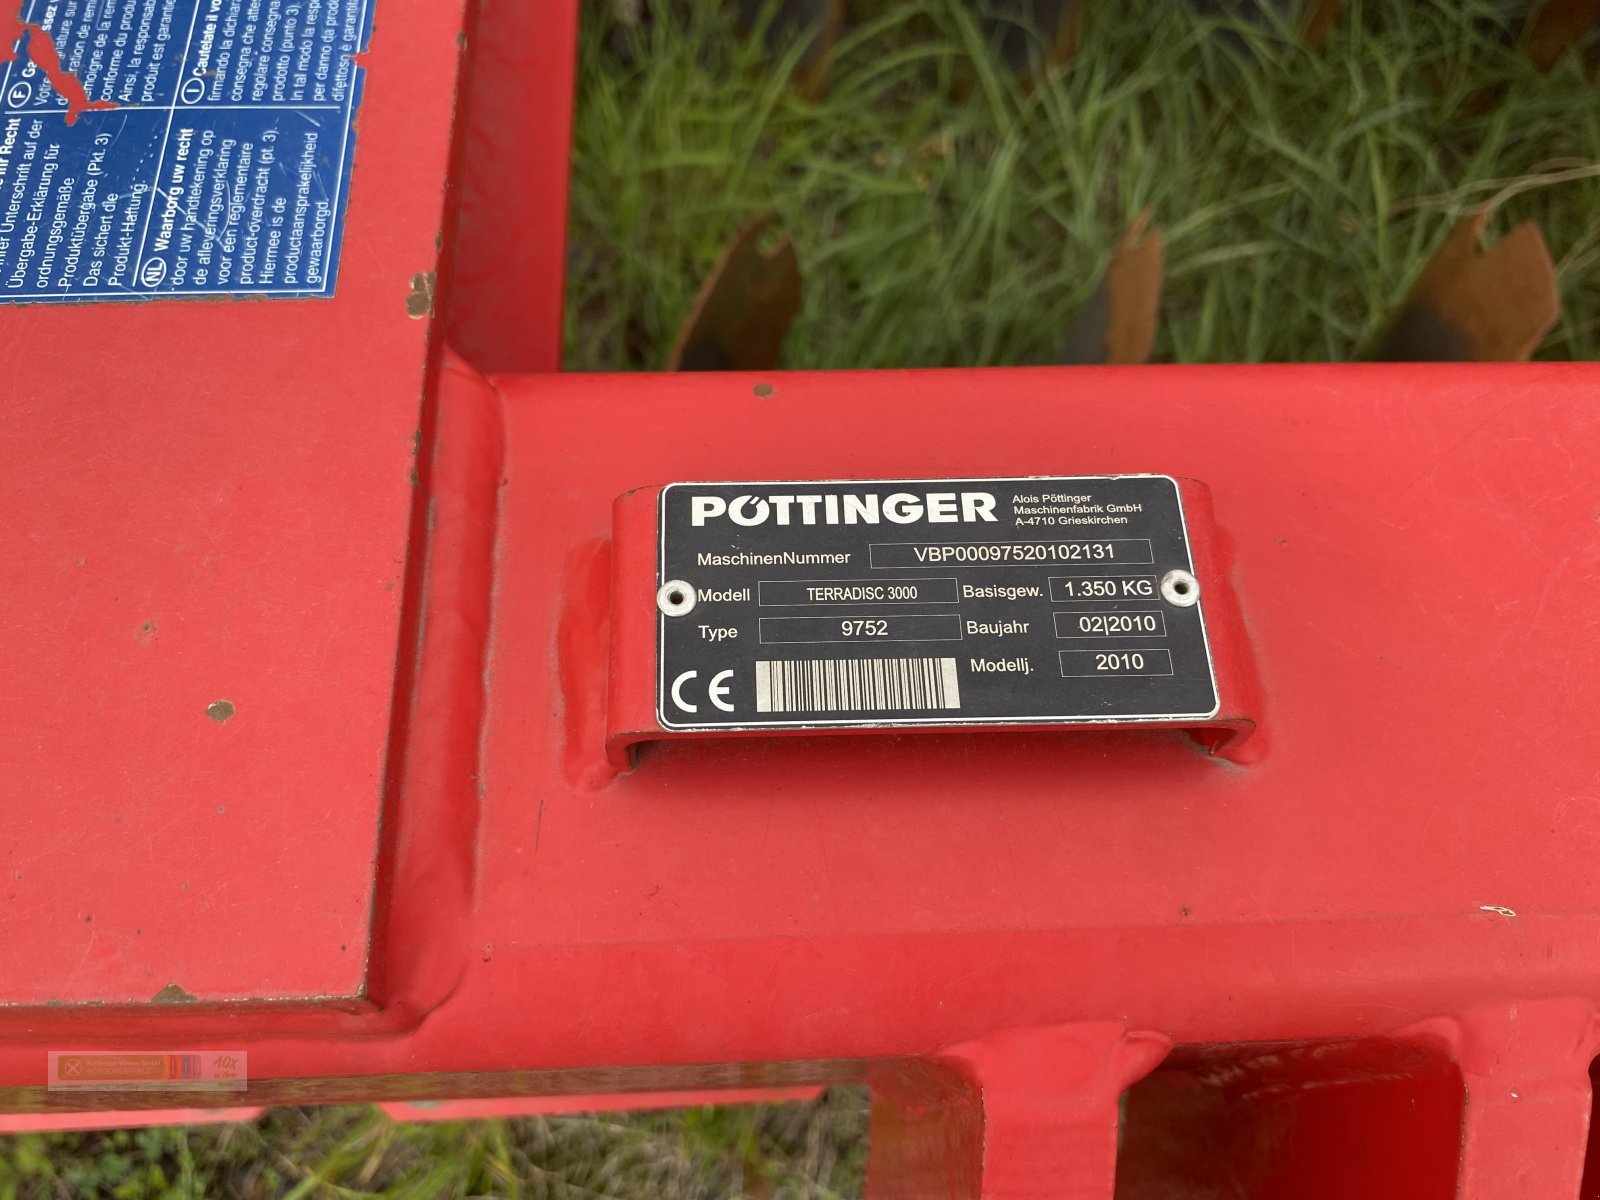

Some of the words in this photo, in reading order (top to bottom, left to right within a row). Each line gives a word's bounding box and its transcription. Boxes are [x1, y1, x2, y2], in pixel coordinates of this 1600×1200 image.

[65, 0, 78, 17] sur
[77, 24, 90, 38] de
[98, 21, 111, 30] la
[279, 18, 297, 52] (punto
[301, 28, 315, 37] la
[94, 34, 108, 47] de
[321, 29, 335, 42] da
[193, 23, 216, 76] Cautelate
[252, 55, 270, 101] regolare
[261, 1, 281, 52] consegna
[298, 40, 313, 71] modo
[101, 50, 123, 101] conforme
[114, 33, 127, 46] du
[127, 58, 141, 67] la
[141, 63, 160, 101] produit
[152, 43, 165, 60] est
[207, 52, 230, 101] firmando
[220, 40, 233, 49] la
[231, 48, 252, 101] consegna
[242, 25, 256, 44] che
[315, 45, 332, 80] danno
[273, 55, 290, 101] prodotto
[293, 74, 307, 87] tal
[331, 55, 350, 101] difettoso
[290, 91, 304, 100] In
[314, 83, 327, 101] per
[0, 118, 21, 154] Recht
[26, 119, 43, 138] der
[200, 130, 215, 145] op
[95, 133, 112, 145] 3)
[174, 128, 194, 161] recht
[23, 141, 37, 160] auf
[86, 149, 105, 175] (Pkt.
[172, 165, 185, 183] uw
[225, 142, 253, 225] reglementaire
[0, 162, 32, 232] Unterschrift
[182, 149, 213, 230] handtekening
[101, 193, 118, 212] die
[196, 139, 236, 264] afleveringsverklaring
[271, 198, 286, 213] de
[284, 132, 318, 283] productaansprakelijkheid
[5, 163, 58, 288] Übergabe-Erklärung
[44, 144, 60, 160] für
[154, 187, 184, 251] Waarborg
[240, 168, 271, 284] product-overdracht
[259, 146, 275, 164] (pt.
[269, 216, 283, 227] is
[37, 178, 74, 288] ordnungsgemäße
[58, 179, 98, 287] Produktübergabe
[92, 215, 114, 257] sichert
[109, 180, 149, 286] Produkt-Haftung.
[224, 230, 237, 252] een
[307, 198, 331, 283] gewaarborgd.
[179, 234, 193, 252] uw
[259, 231, 281, 283] Hiermee
[83, 261, 102, 286] Das
[146, 263, 162, 281] NL
[171, 256, 188, 285] door
[193, 269, 208, 285] de
[218, 256, 232, 285] voor
[1012, 495, 1039, 503] Alois
[1042, 494, 1092, 504] Pöttinger
[691, 493, 998, 527] PÖTTINGER
[1014, 504, 1103, 515] Maschinenfabrik
[1107, 504, 1142, 513] GmbH
[1016, 517, 1055, 526] A-4710
[1058, 516, 1128, 525] Grieskirchen
[697, 552, 851, 566] MaschinenNummer
[914, 544, 1114, 562] VBP00097520102131
[697, 589, 750, 602] Modell
[807, 587, 884, 600] TERRADISC
[888, 586, 918, 599] 3000
[963, 585, 1044, 600] Basisgew.
[1064, 581, 1116, 596] 1.350
[1122, 580, 1153, 595] KG
[698, 625, 738, 641] Type
[841, 621, 888, 636] 9752
[967, 621, 1029, 636] Baujahr
[971, 658, 1034, 674] Modellj.
[1095, 654, 1144, 670] 2010
